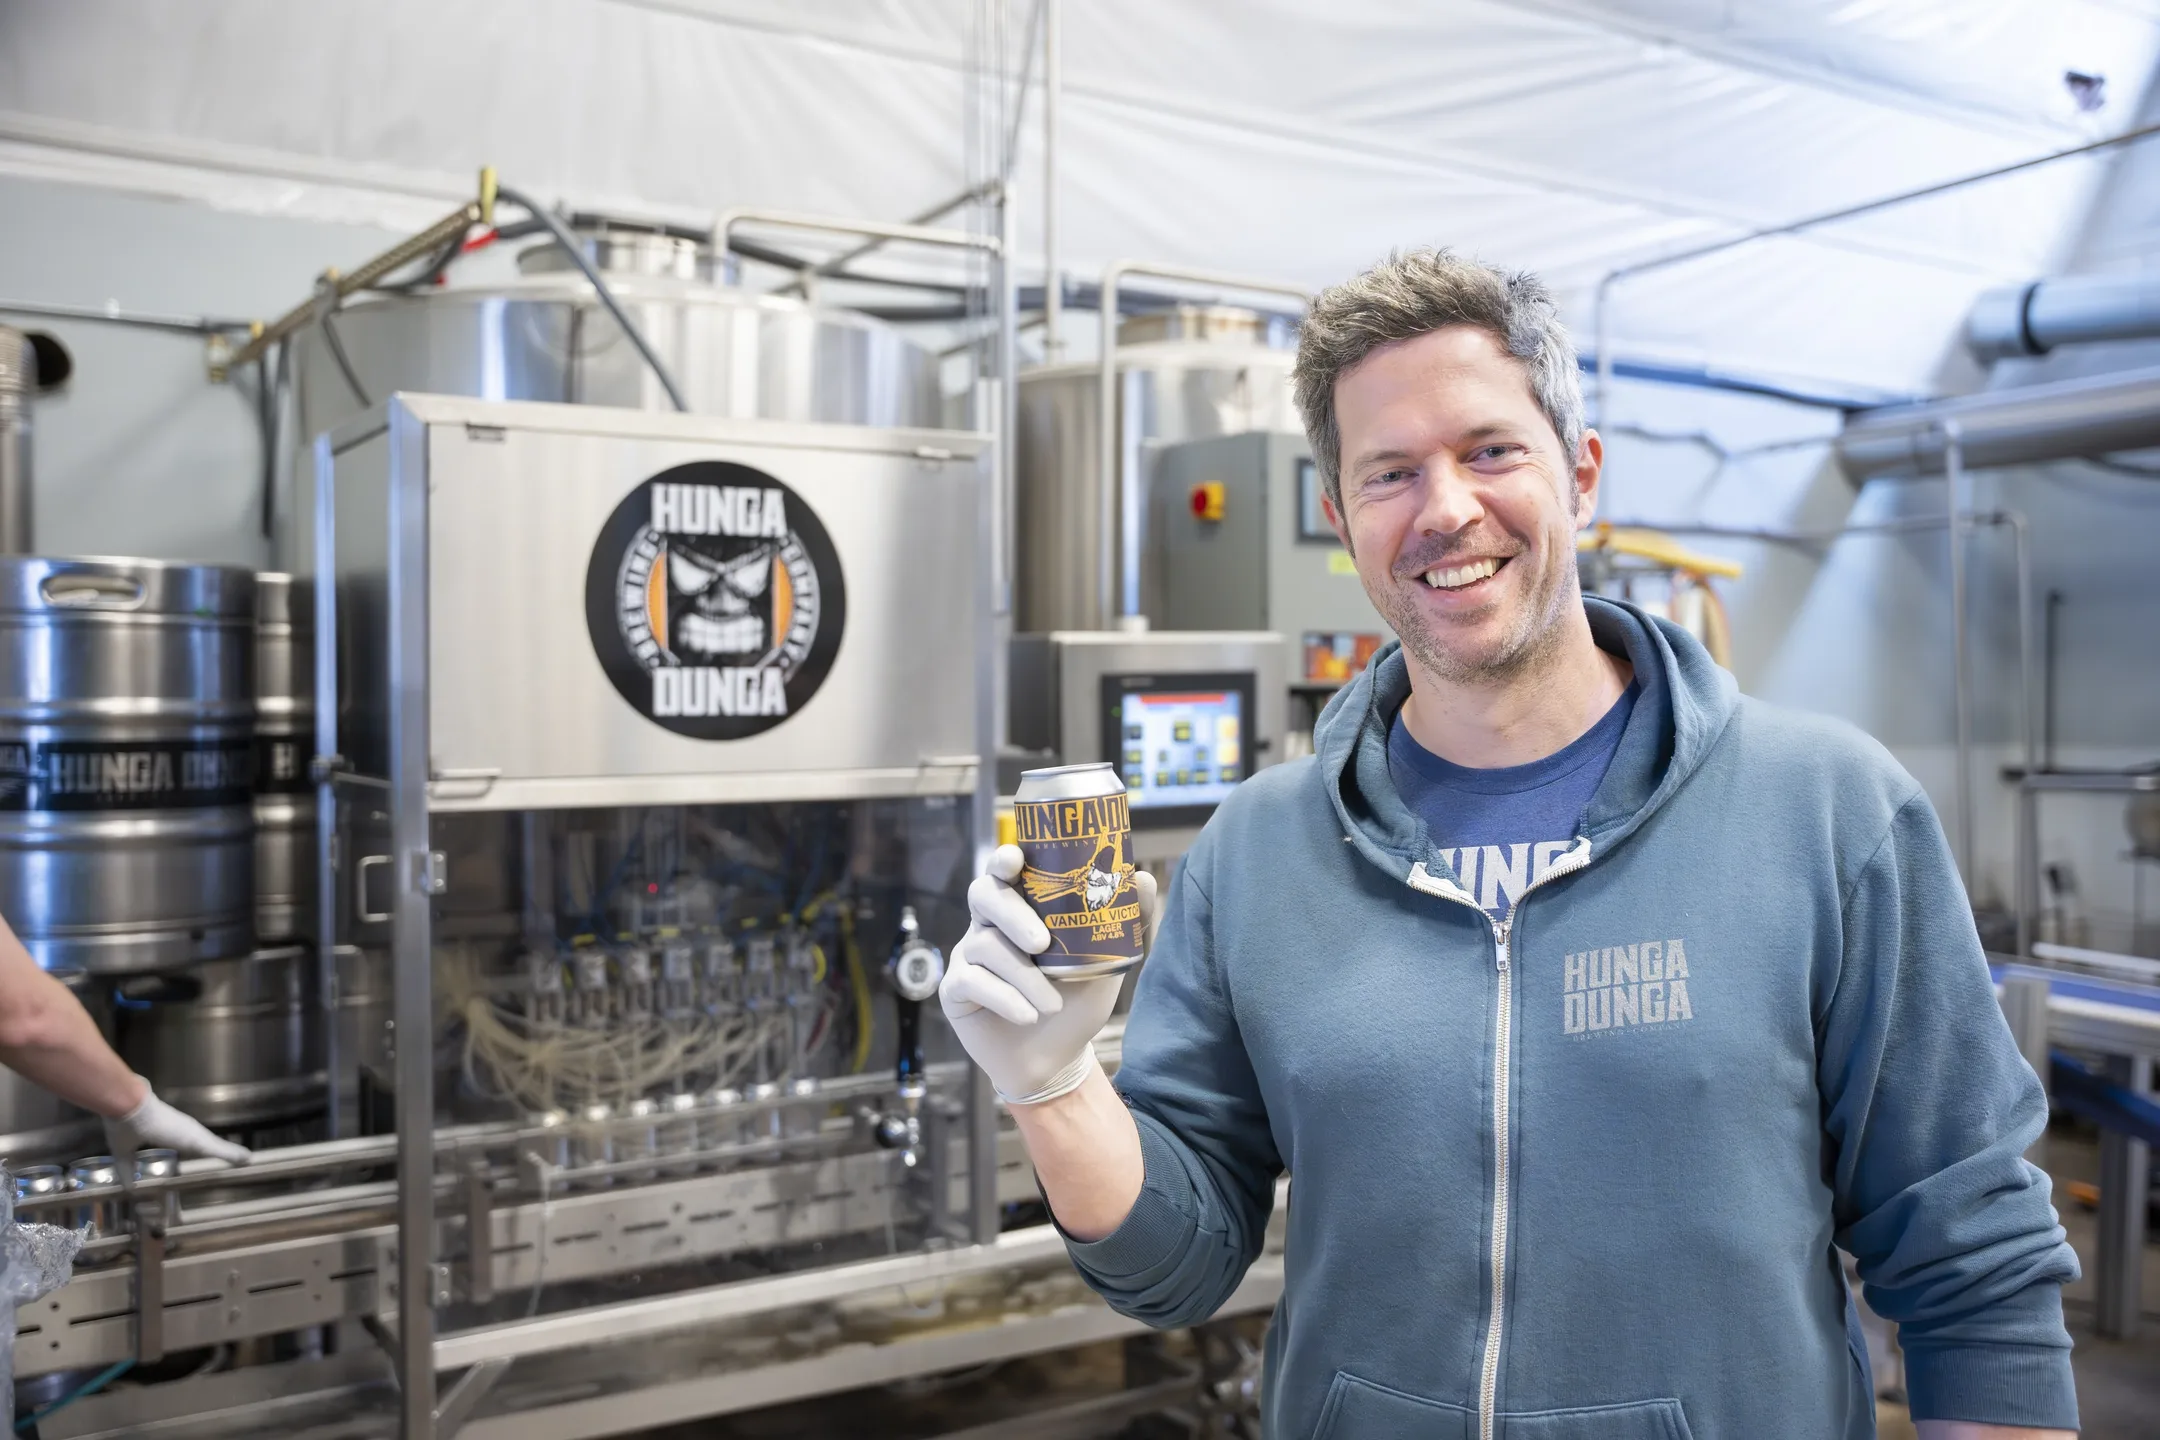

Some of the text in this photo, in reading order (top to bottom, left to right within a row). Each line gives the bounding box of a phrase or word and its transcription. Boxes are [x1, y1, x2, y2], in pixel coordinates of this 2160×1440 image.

[651, 482, 787, 538] HUNGA
[652, 667, 787, 717] DUNGA
[50, 751, 174, 793] HUNGA
[1050, 911, 1106, 927] VANDAL
[1091, 933, 1106, 942] ABV
[1092, 922, 1122, 935] LAGER
[1564, 939, 1690, 993] HUNGA
[1563, 980, 1693, 1035] DUNGA
